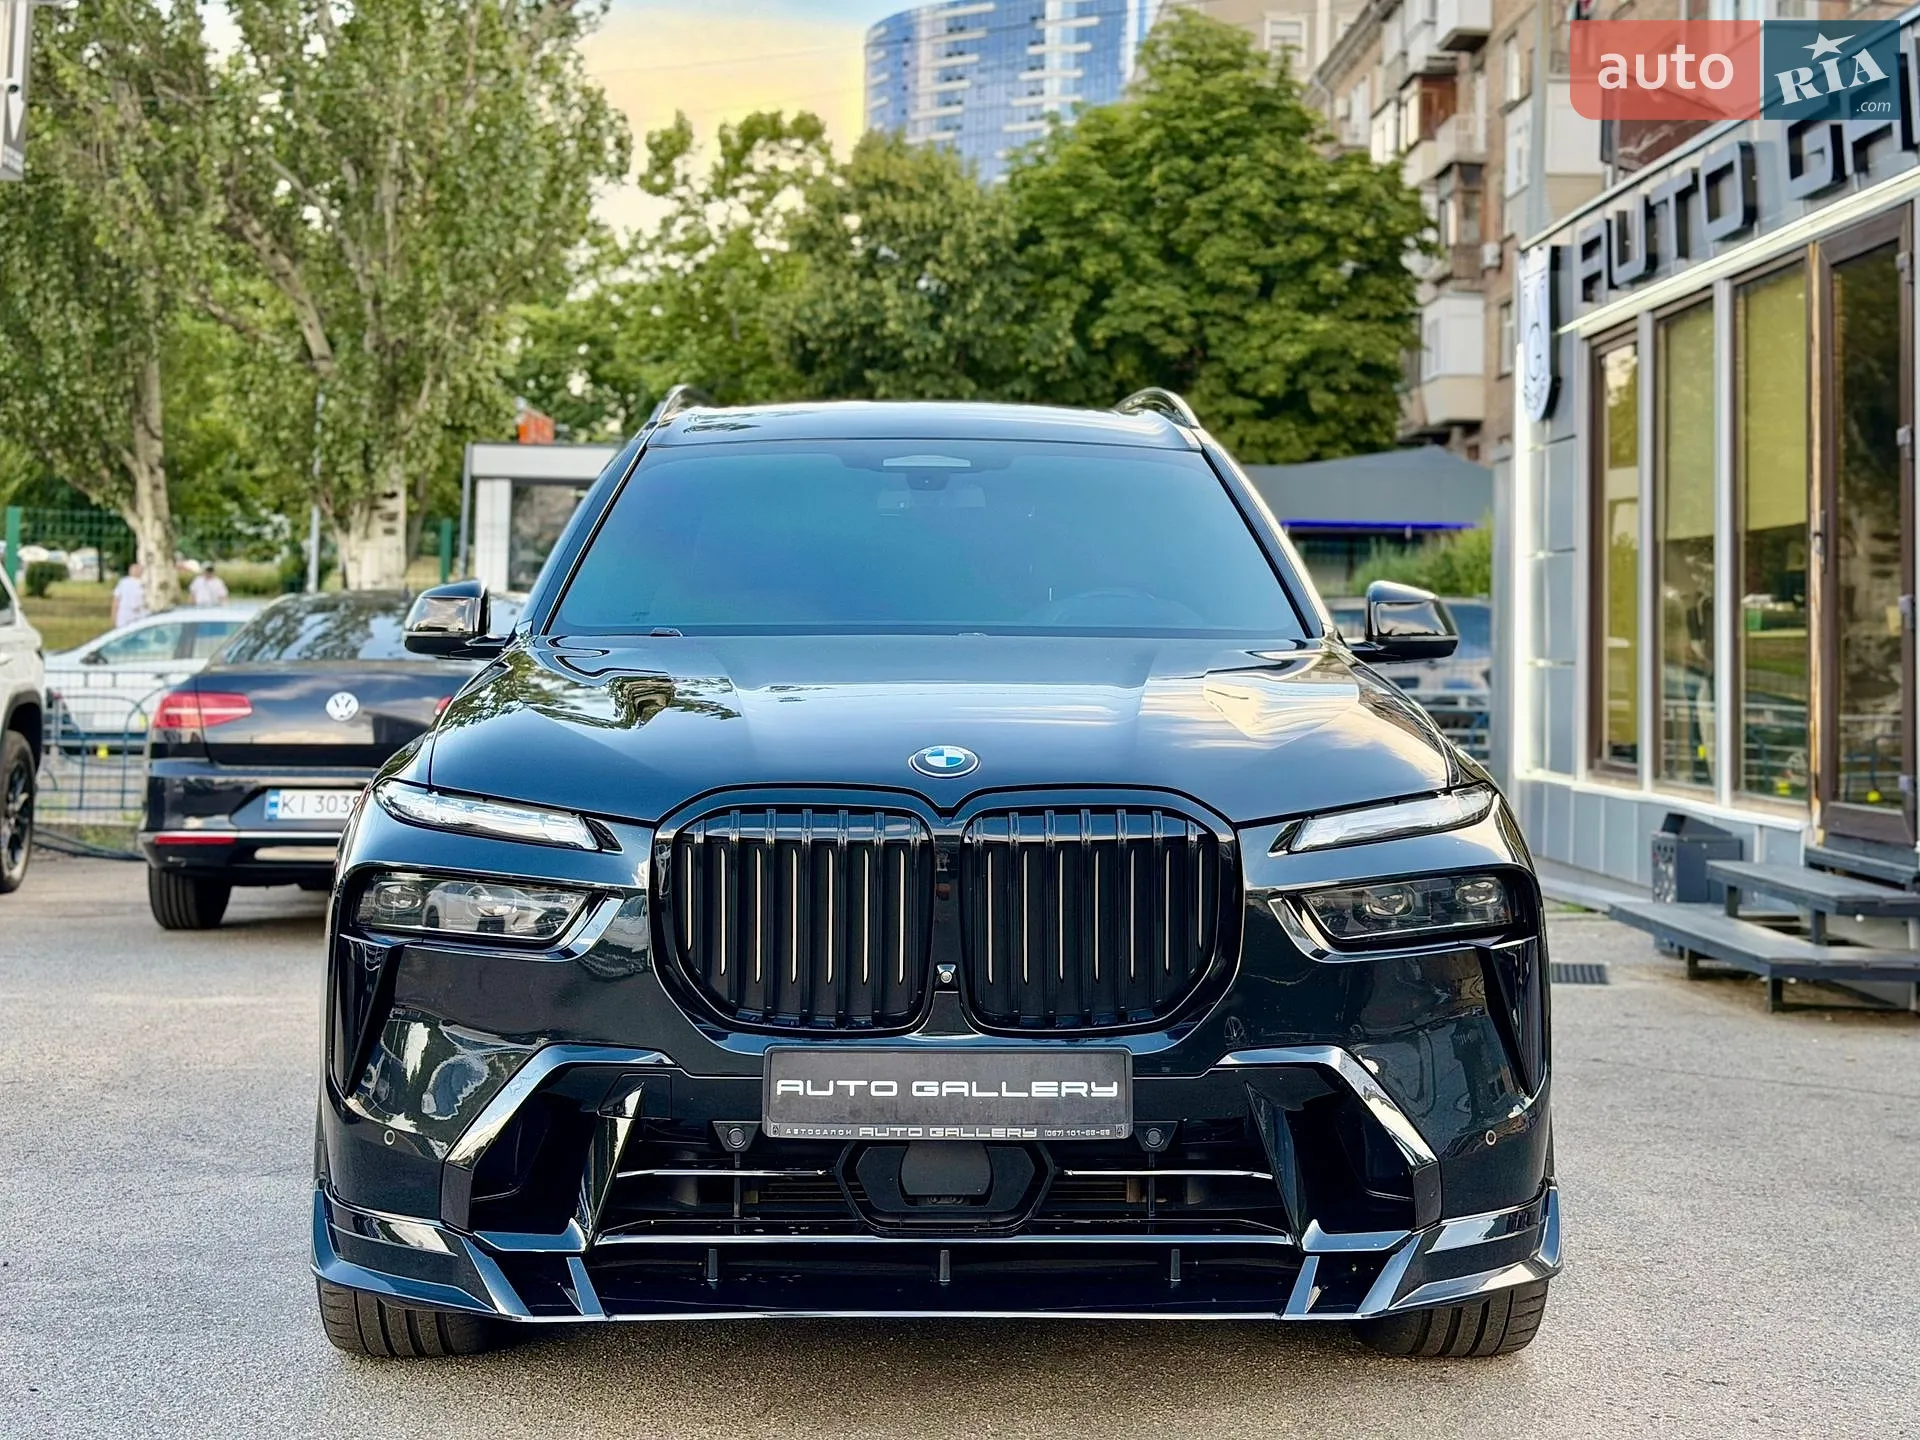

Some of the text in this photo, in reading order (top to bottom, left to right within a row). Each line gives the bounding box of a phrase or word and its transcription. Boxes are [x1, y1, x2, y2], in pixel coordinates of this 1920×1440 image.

[1577, 141, 1757, 304] AUTO
[281, 795, 306, 813] KI
[776, 1079, 1119, 1098] AUTO GALLERY
[859, 1127, 1037, 1138] AUTO GALLERY
